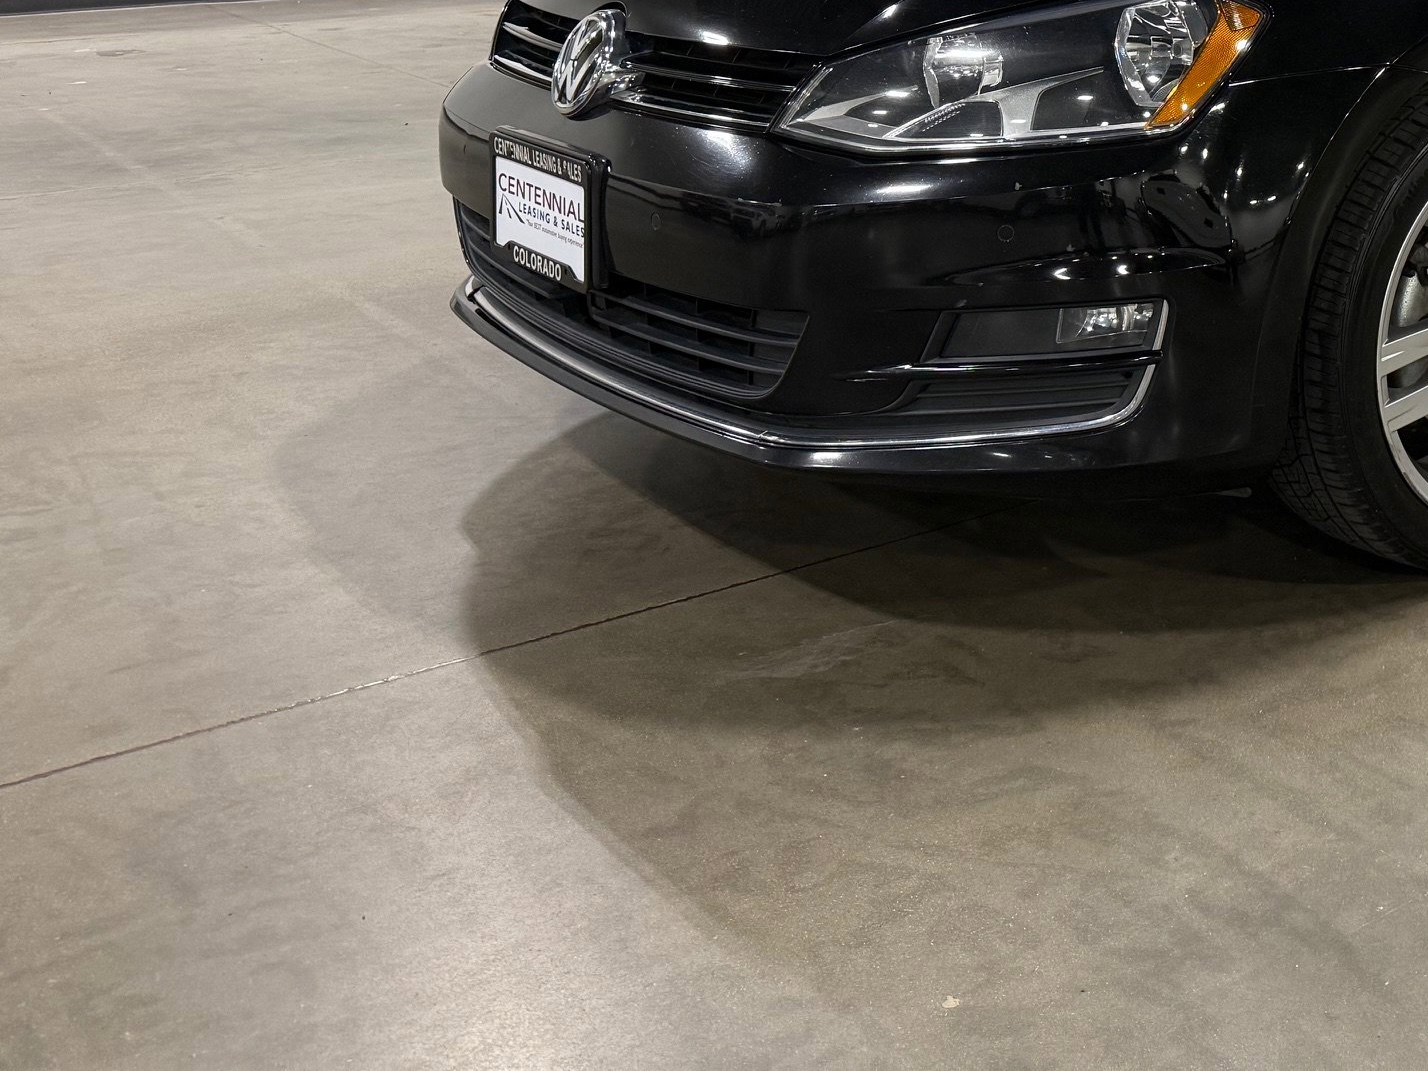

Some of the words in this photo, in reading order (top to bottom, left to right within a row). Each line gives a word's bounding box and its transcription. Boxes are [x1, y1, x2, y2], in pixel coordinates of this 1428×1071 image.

[532, 149, 557, 173] LEASING
[557, 158, 563, 175] &
[498, 172, 585, 223] CENTENNIAL
[518, 201, 551, 224] LEASING
[553, 215, 558, 227] &
[561, 219, 585, 238] SALES
[513, 245, 562, 281] COLORADO
